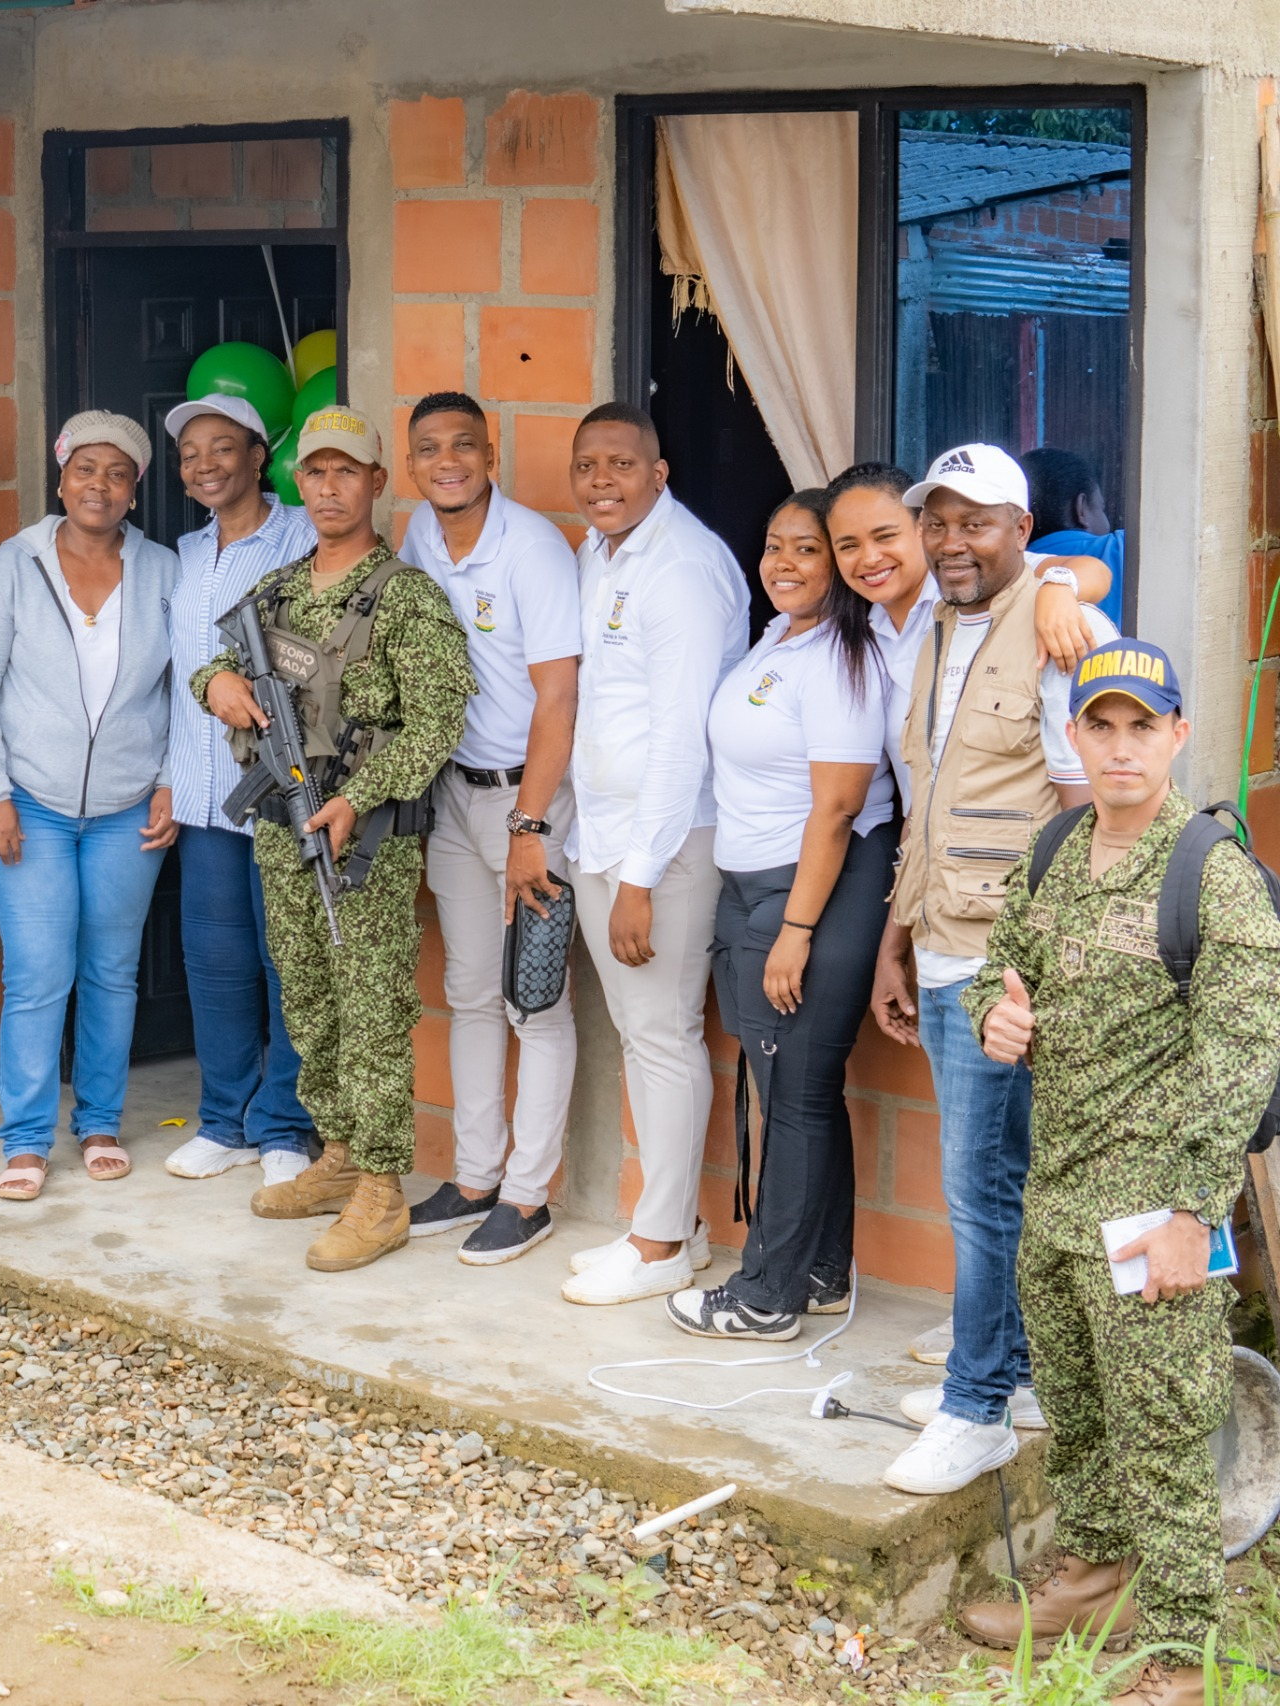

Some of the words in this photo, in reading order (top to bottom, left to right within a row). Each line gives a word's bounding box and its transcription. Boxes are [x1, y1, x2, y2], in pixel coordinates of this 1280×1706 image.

[938, 464, 976, 475] adidas
[1077, 649, 1165, 687] ARMADA
[1109, 939, 1158, 956] ARMADA
